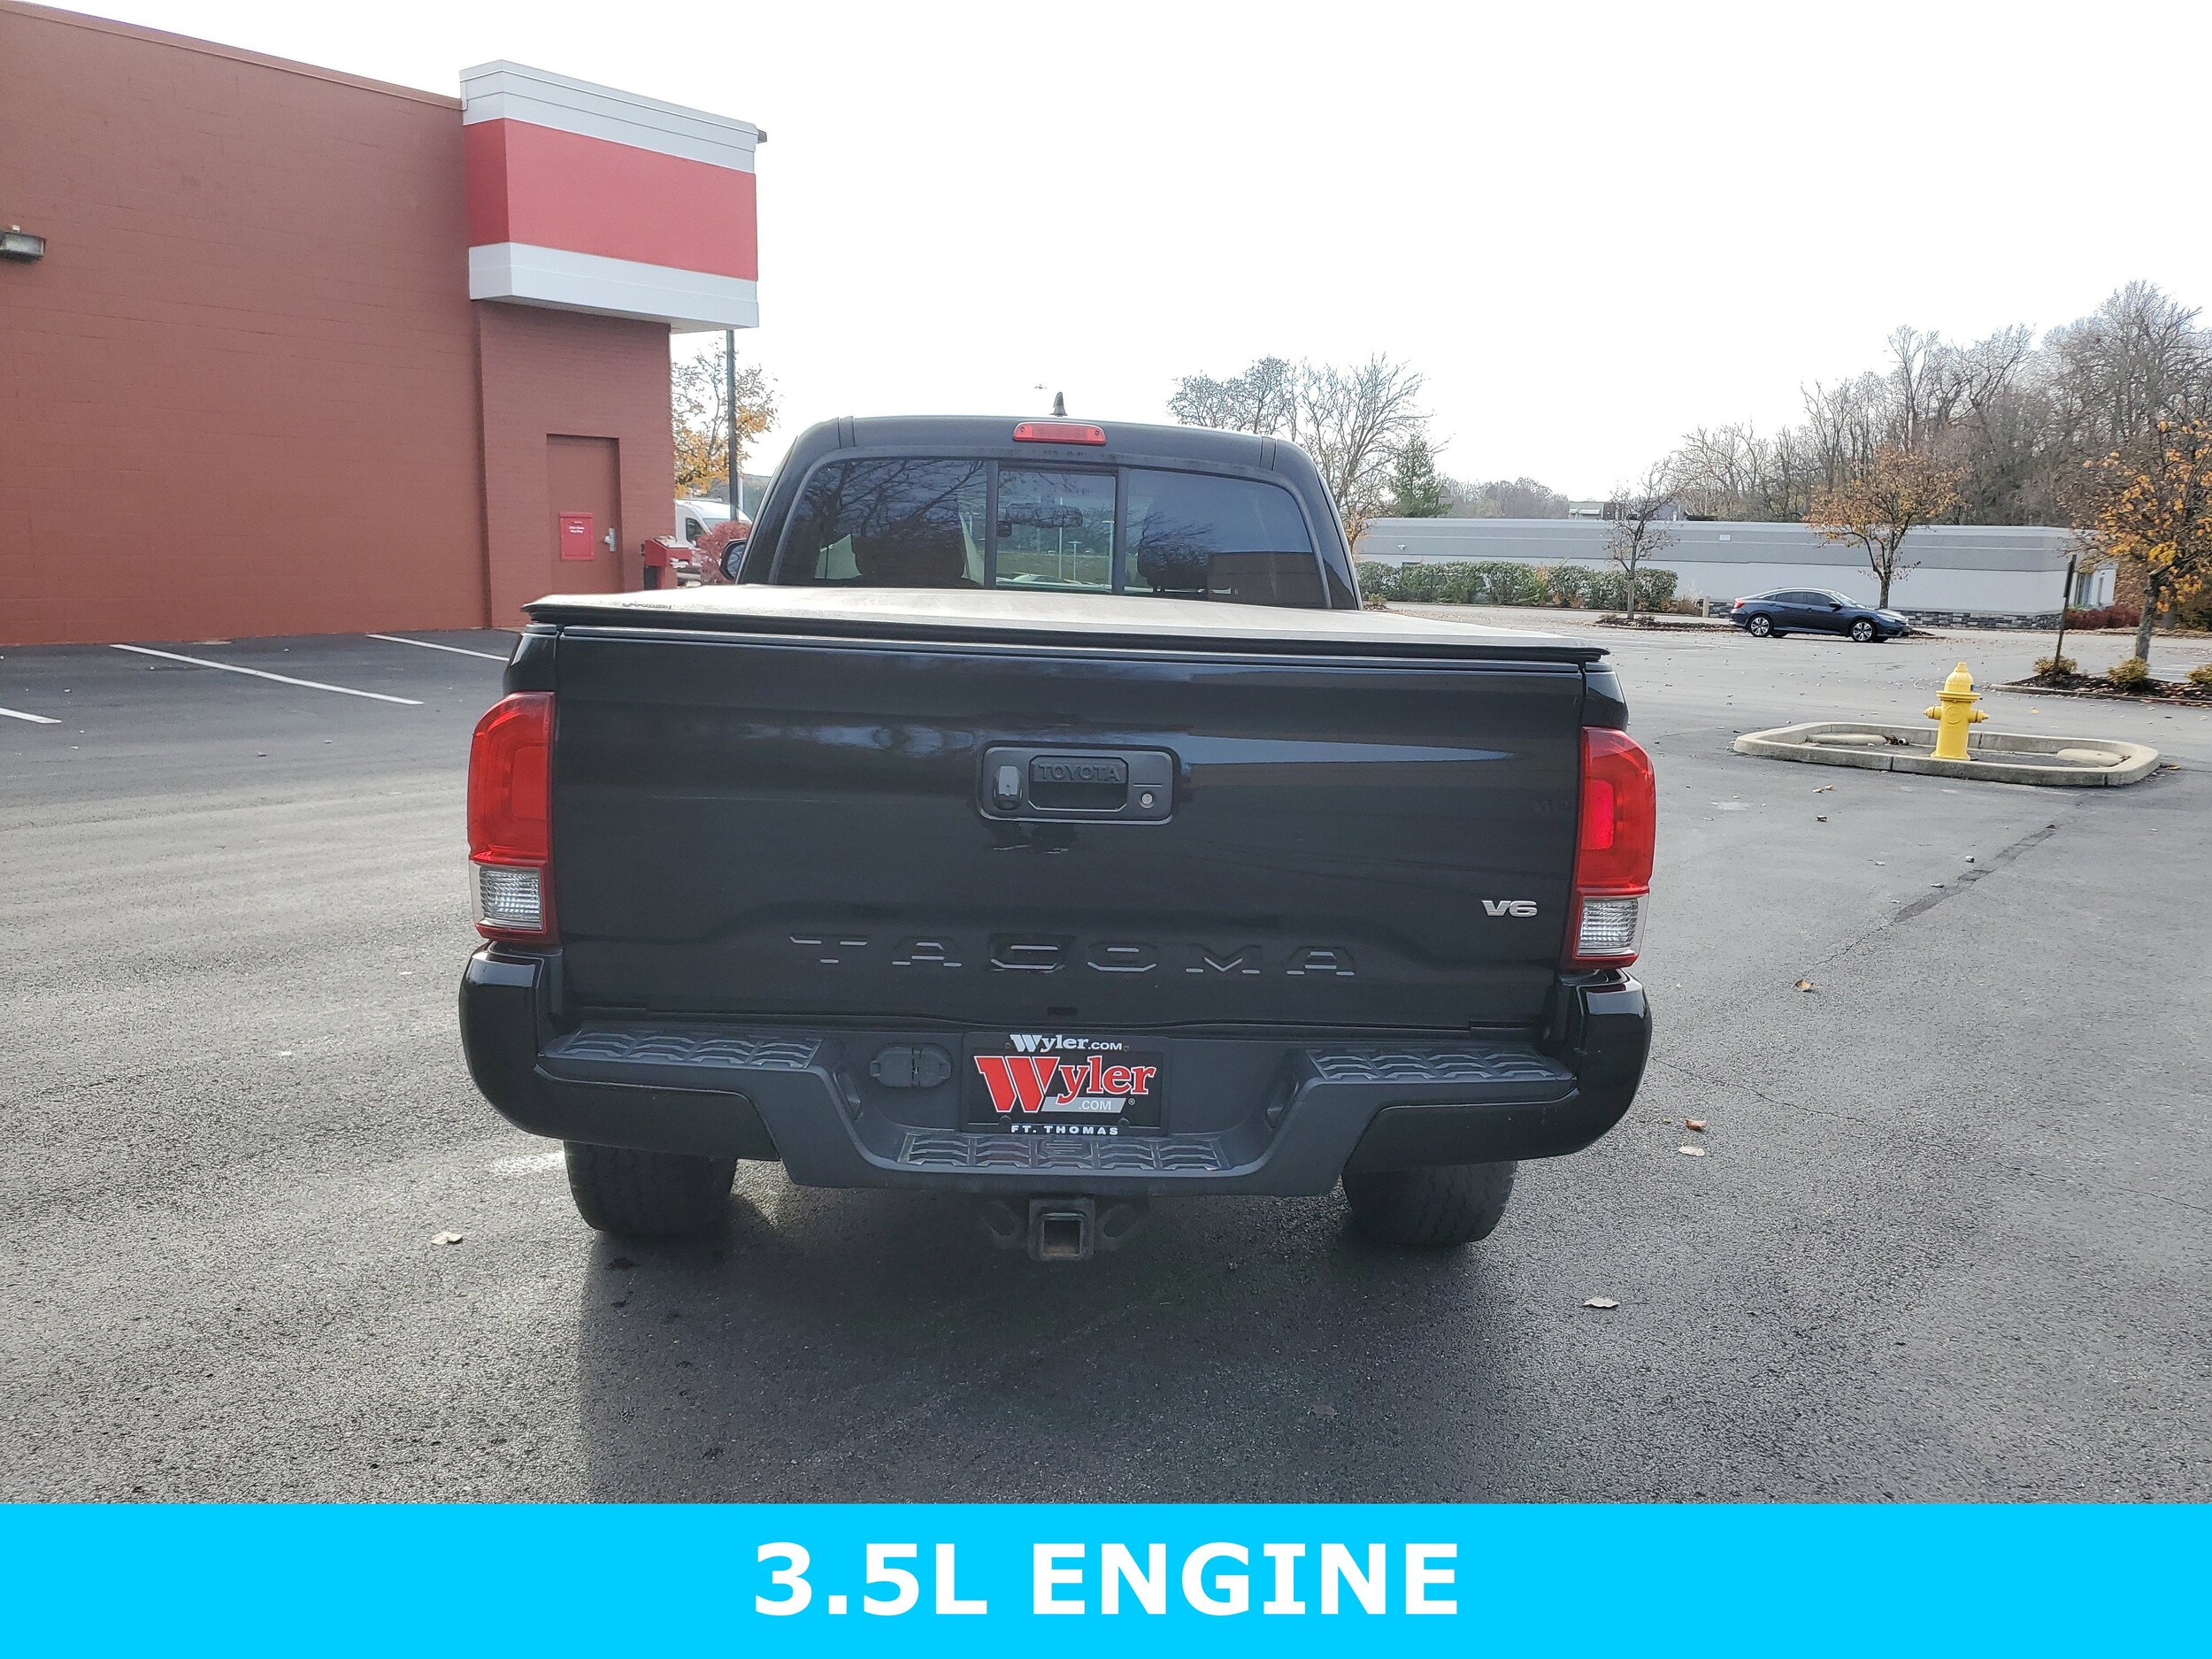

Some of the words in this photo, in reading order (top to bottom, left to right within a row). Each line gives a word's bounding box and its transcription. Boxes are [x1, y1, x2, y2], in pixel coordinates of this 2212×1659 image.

[1038, 764, 1121, 782] TOYOTA
[1481, 900, 1538, 918] V6
[789, 933, 1356, 976] TACOMA
[974, 1056, 1156, 1113] Wyler
[1010, 1125, 1038, 1134] FT.
[1043, 1125, 1118, 1136] THOMAS
